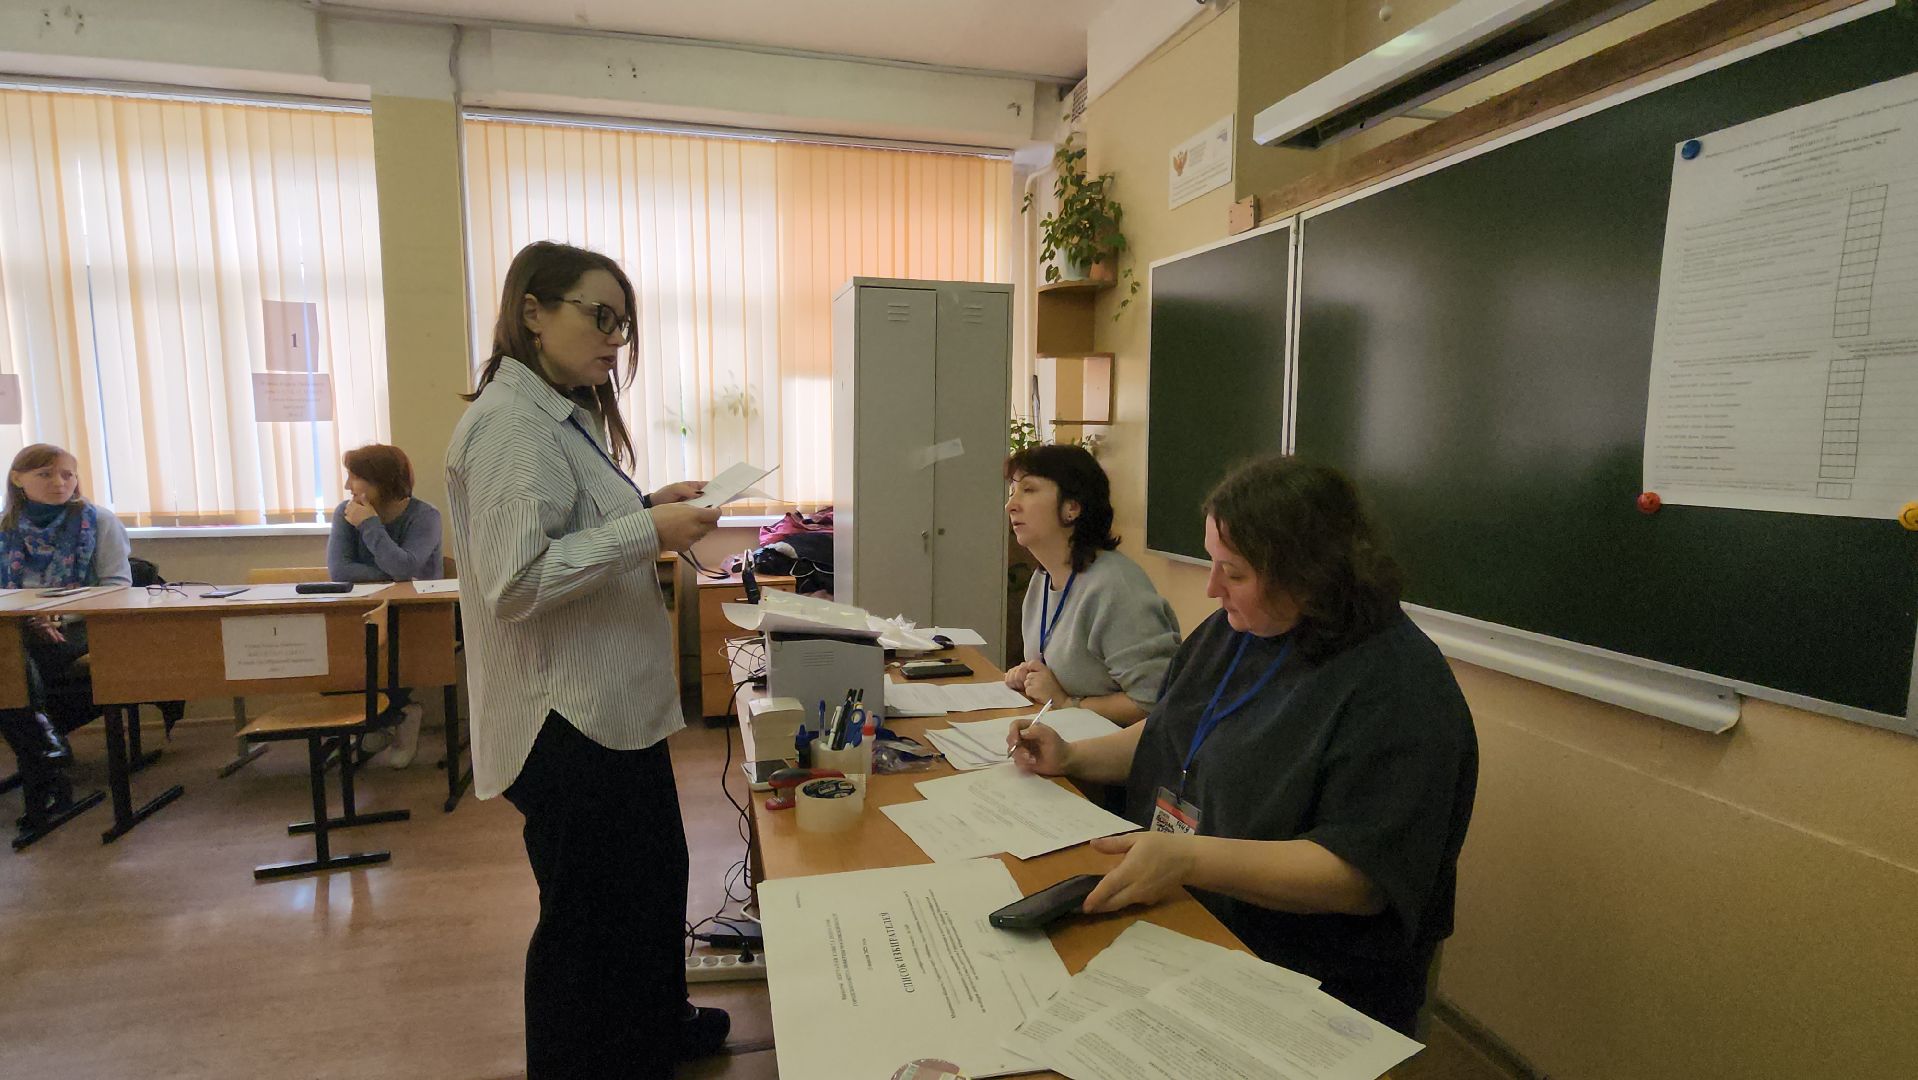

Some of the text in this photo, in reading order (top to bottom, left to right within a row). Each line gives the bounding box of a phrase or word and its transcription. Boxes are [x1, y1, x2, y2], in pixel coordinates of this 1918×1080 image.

[290, 332, 298, 348] 1
[272, 626, 278, 636] 1
[879, 912, 915, 993] СПИСОК ИЗБИРАТЕЛЕЙ
